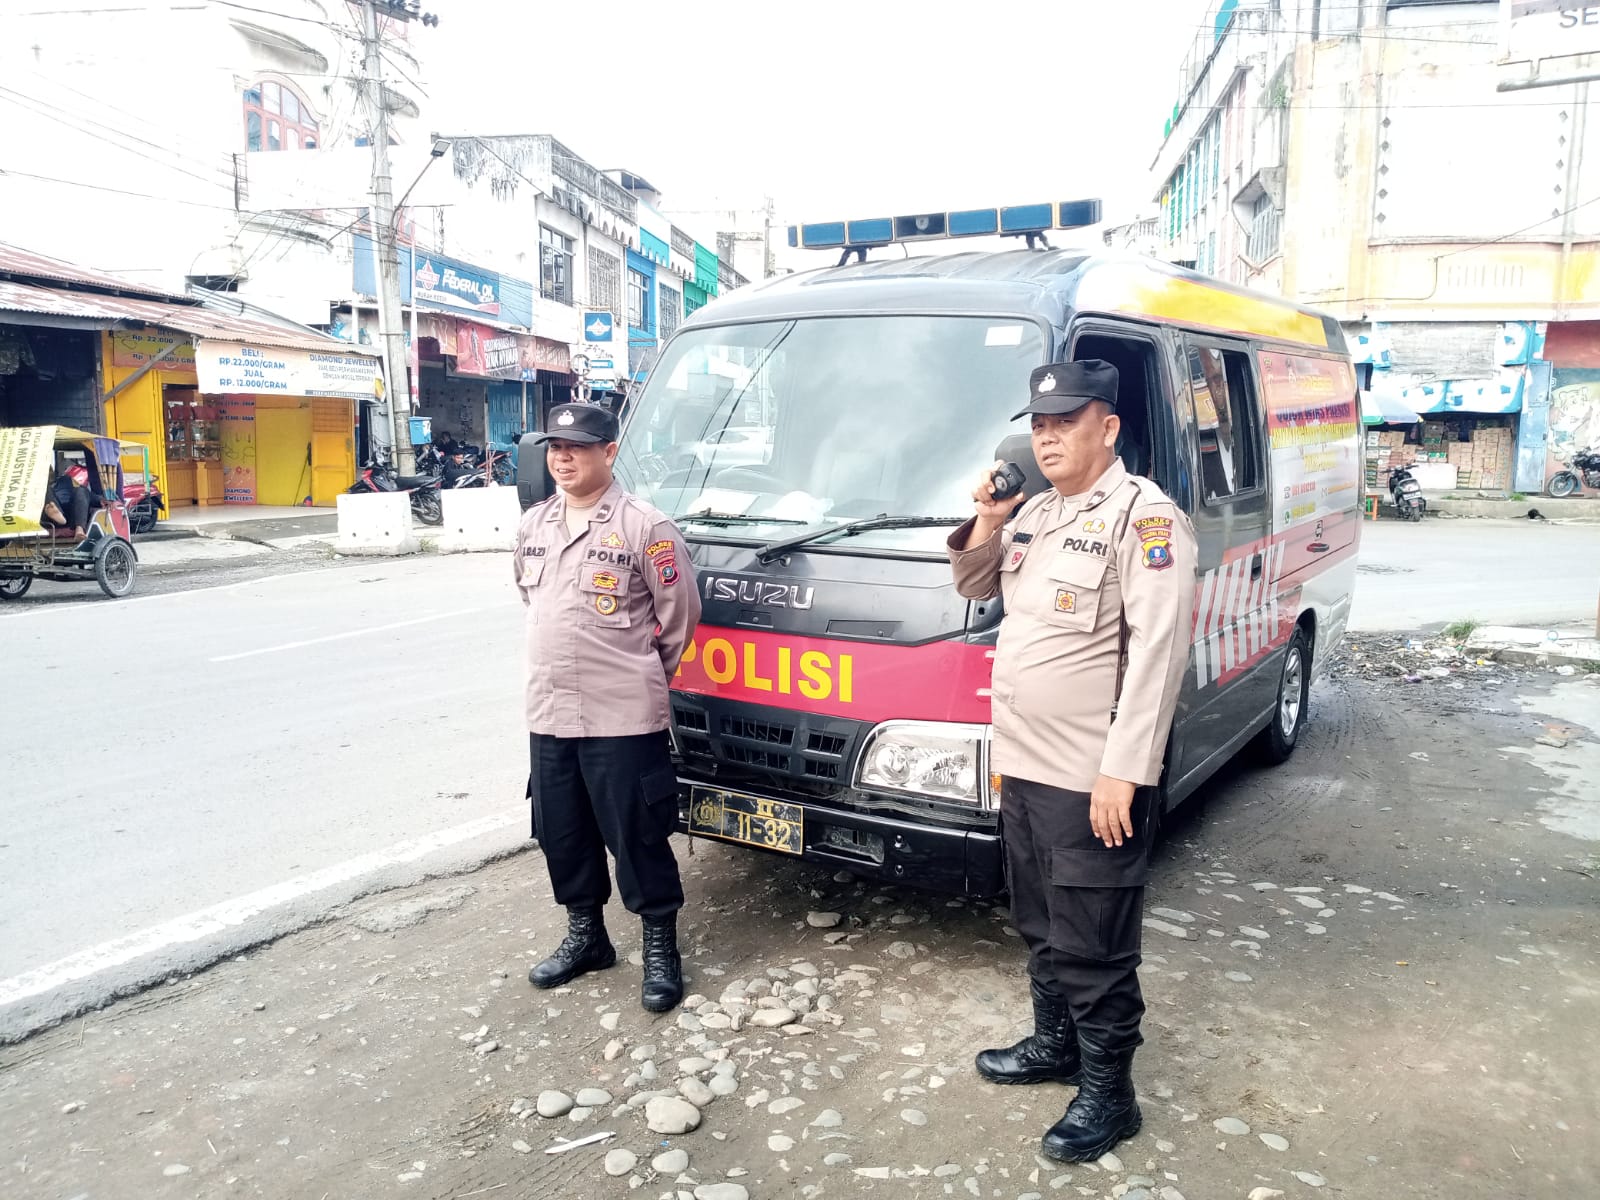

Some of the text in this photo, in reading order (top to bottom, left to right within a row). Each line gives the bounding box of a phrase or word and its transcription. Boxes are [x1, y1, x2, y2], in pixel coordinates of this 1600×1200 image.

[442, 273, 480, 295] FEDERAL
[481, 284, 495, 298] OIL
[309, 354, 343, 364] DIAMOND
[243, 369, 264, 378] JUAL
[19, 427, 32, 445] IGA
[8, 448, 28, 492] MUSTIKA
[1, 495, 17, 525] ABADI
[587, 549, 632, 566] POLRI
[1063, 537, 1108, 556] POLRI
[704, 576, 815, 610] ISUZU
[675, 638, 853, 703] POLISI
[737, 812, 792, 850] 11-32
